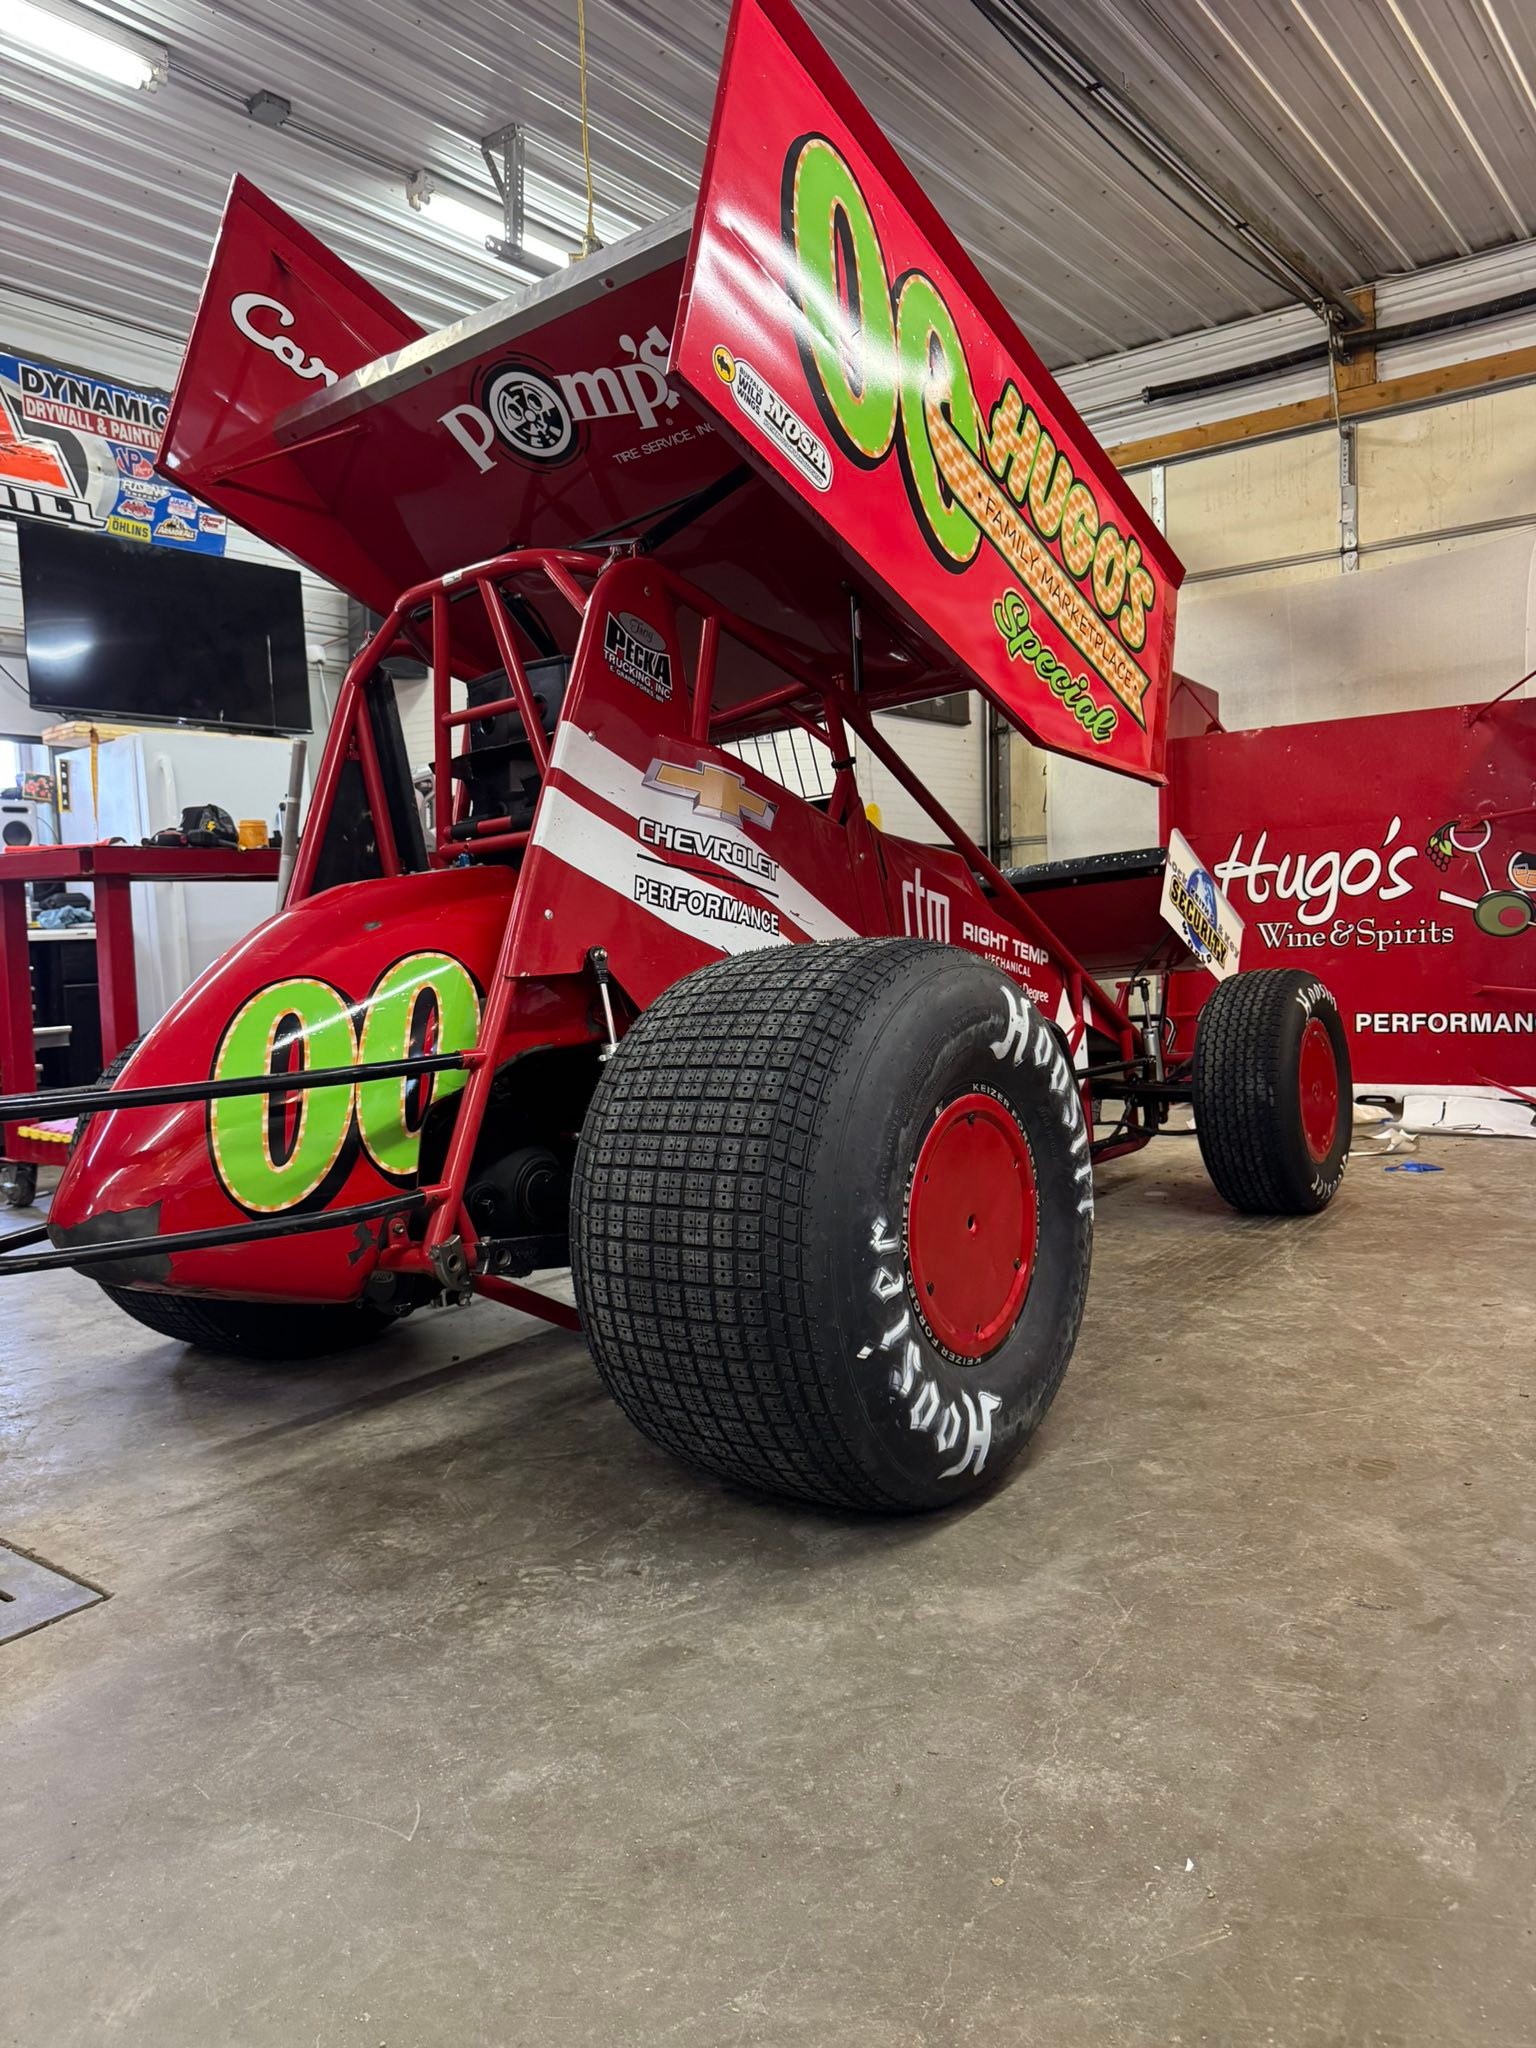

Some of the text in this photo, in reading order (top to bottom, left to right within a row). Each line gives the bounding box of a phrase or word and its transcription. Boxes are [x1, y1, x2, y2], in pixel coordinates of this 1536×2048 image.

[737, 384, 760, 416] WINGS
[738, 374, 762, 406] WILD
[739, 366, 763, 395] BUFFALO
[25, 398, 95, 433] DRYWALL
[97, 417, 108, 436] &
[612, 448, 641, 464] TIRE
[641, 429, 696, 454] SERVICE,
[982, 378, 1155, 653] HUGO'S
[984, 496, 1133, 690] FAMILY MARKETPLACE
[604, 611, 673, 691] PECKA
[993, 588, 1118, 744] Special
[655, 683, 673, 702] INC.
[637, 816, 780, 882] CHEVROLET
[1213, 815, 1420, 926] Hugo's
[634, 875, 780, 936] PERFORMANCE
[902, 868, 950, 944] rtm
[1170, 876, 1228, 966] SECURITY
[962, 921, 1049, 966] RIGHT TEMP
[1257, 917, 1455, 952] Wine & Spirits
[1355, 1012, 1536, 1034] PERFORMAN
[206, 949, 487, 1220] 00
[972, 1083, 1011, 1110] KEIZER
[905, 1270, 941, 1347] FORGED
[940, 1345, 983, 1366] KEIZER
